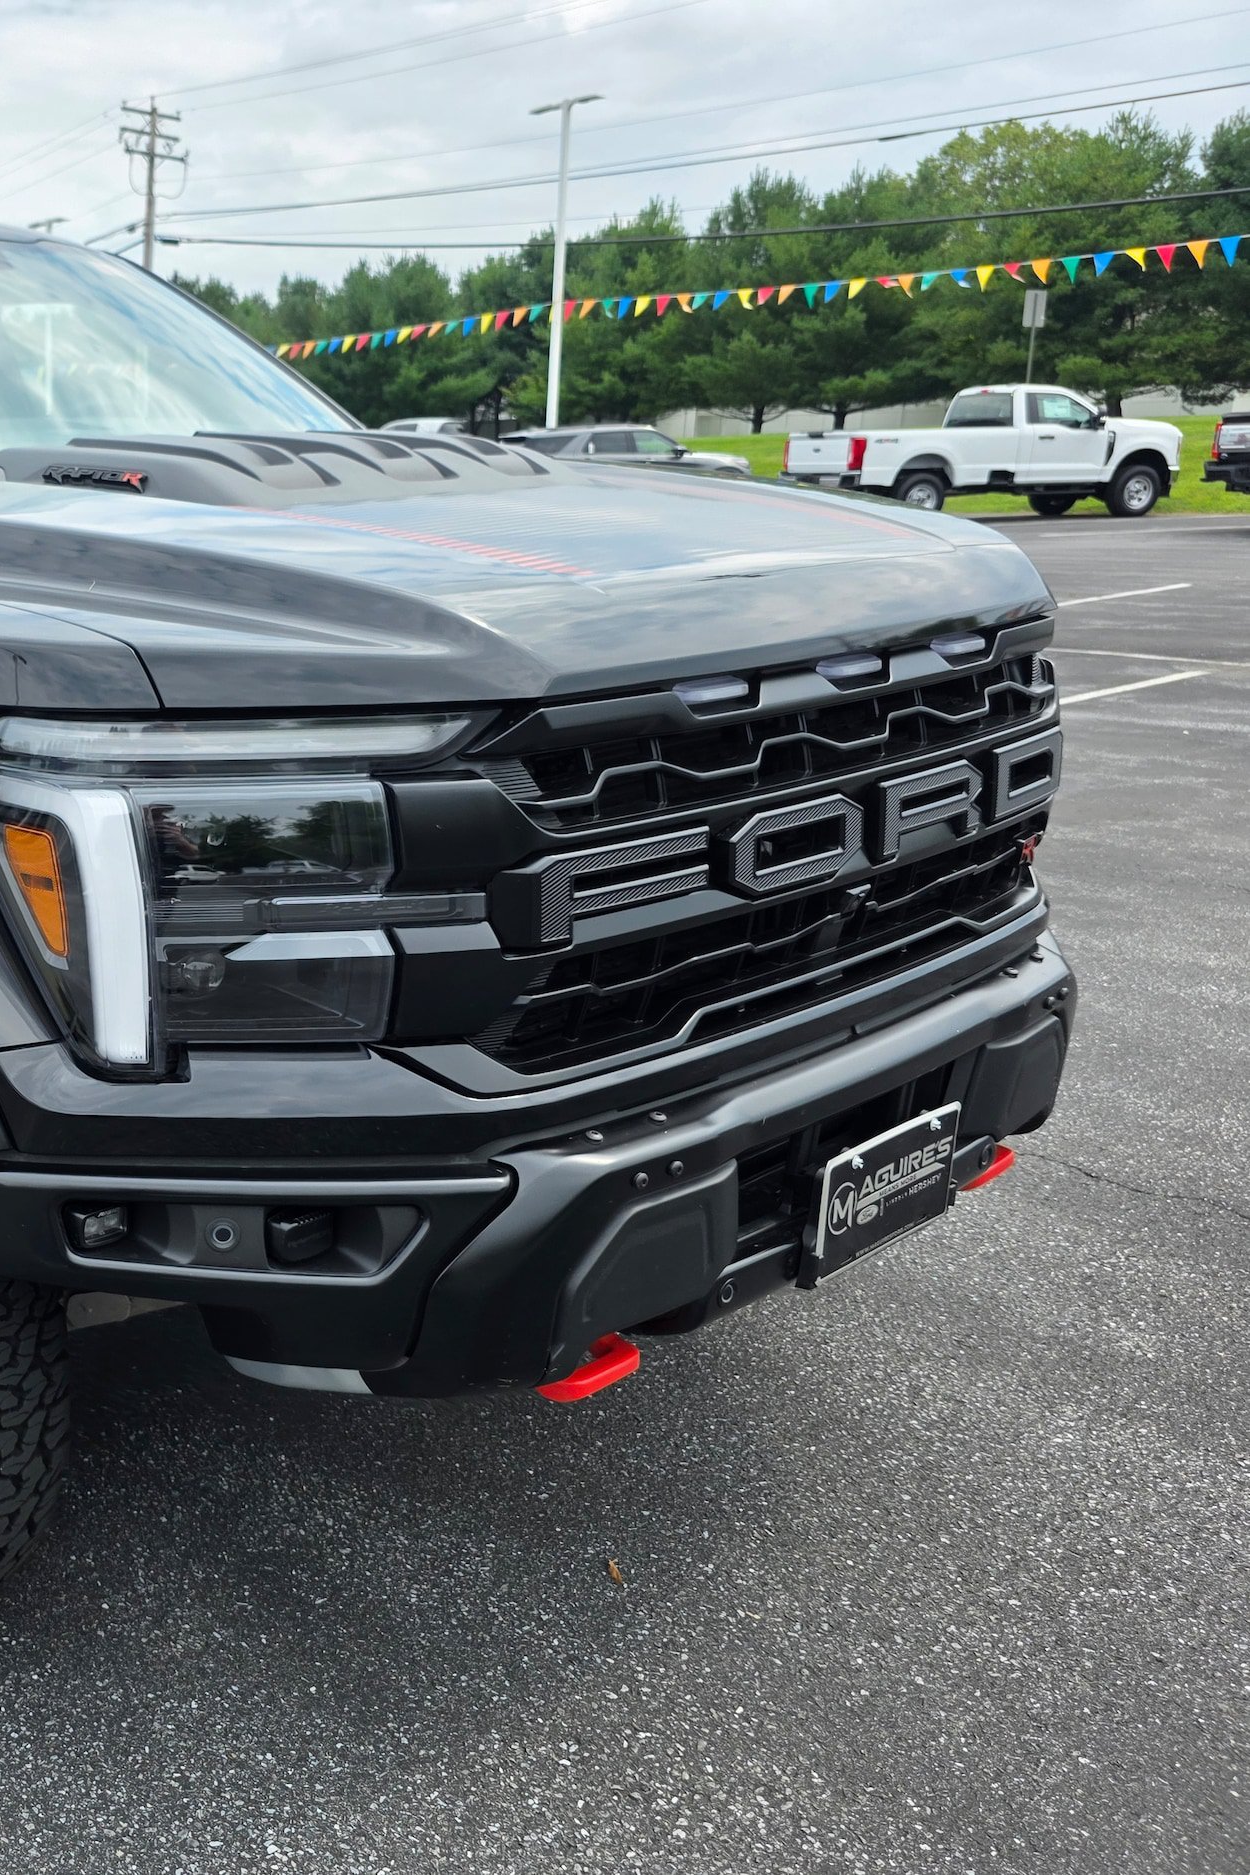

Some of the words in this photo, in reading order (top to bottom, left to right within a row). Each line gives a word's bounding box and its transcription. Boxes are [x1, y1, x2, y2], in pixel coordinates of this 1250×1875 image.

[45, 464, 146, 494] RAPTOR
[538, 726, 1062, 945] FORD
[908, 1173, 942, 1196] HERSHEY
